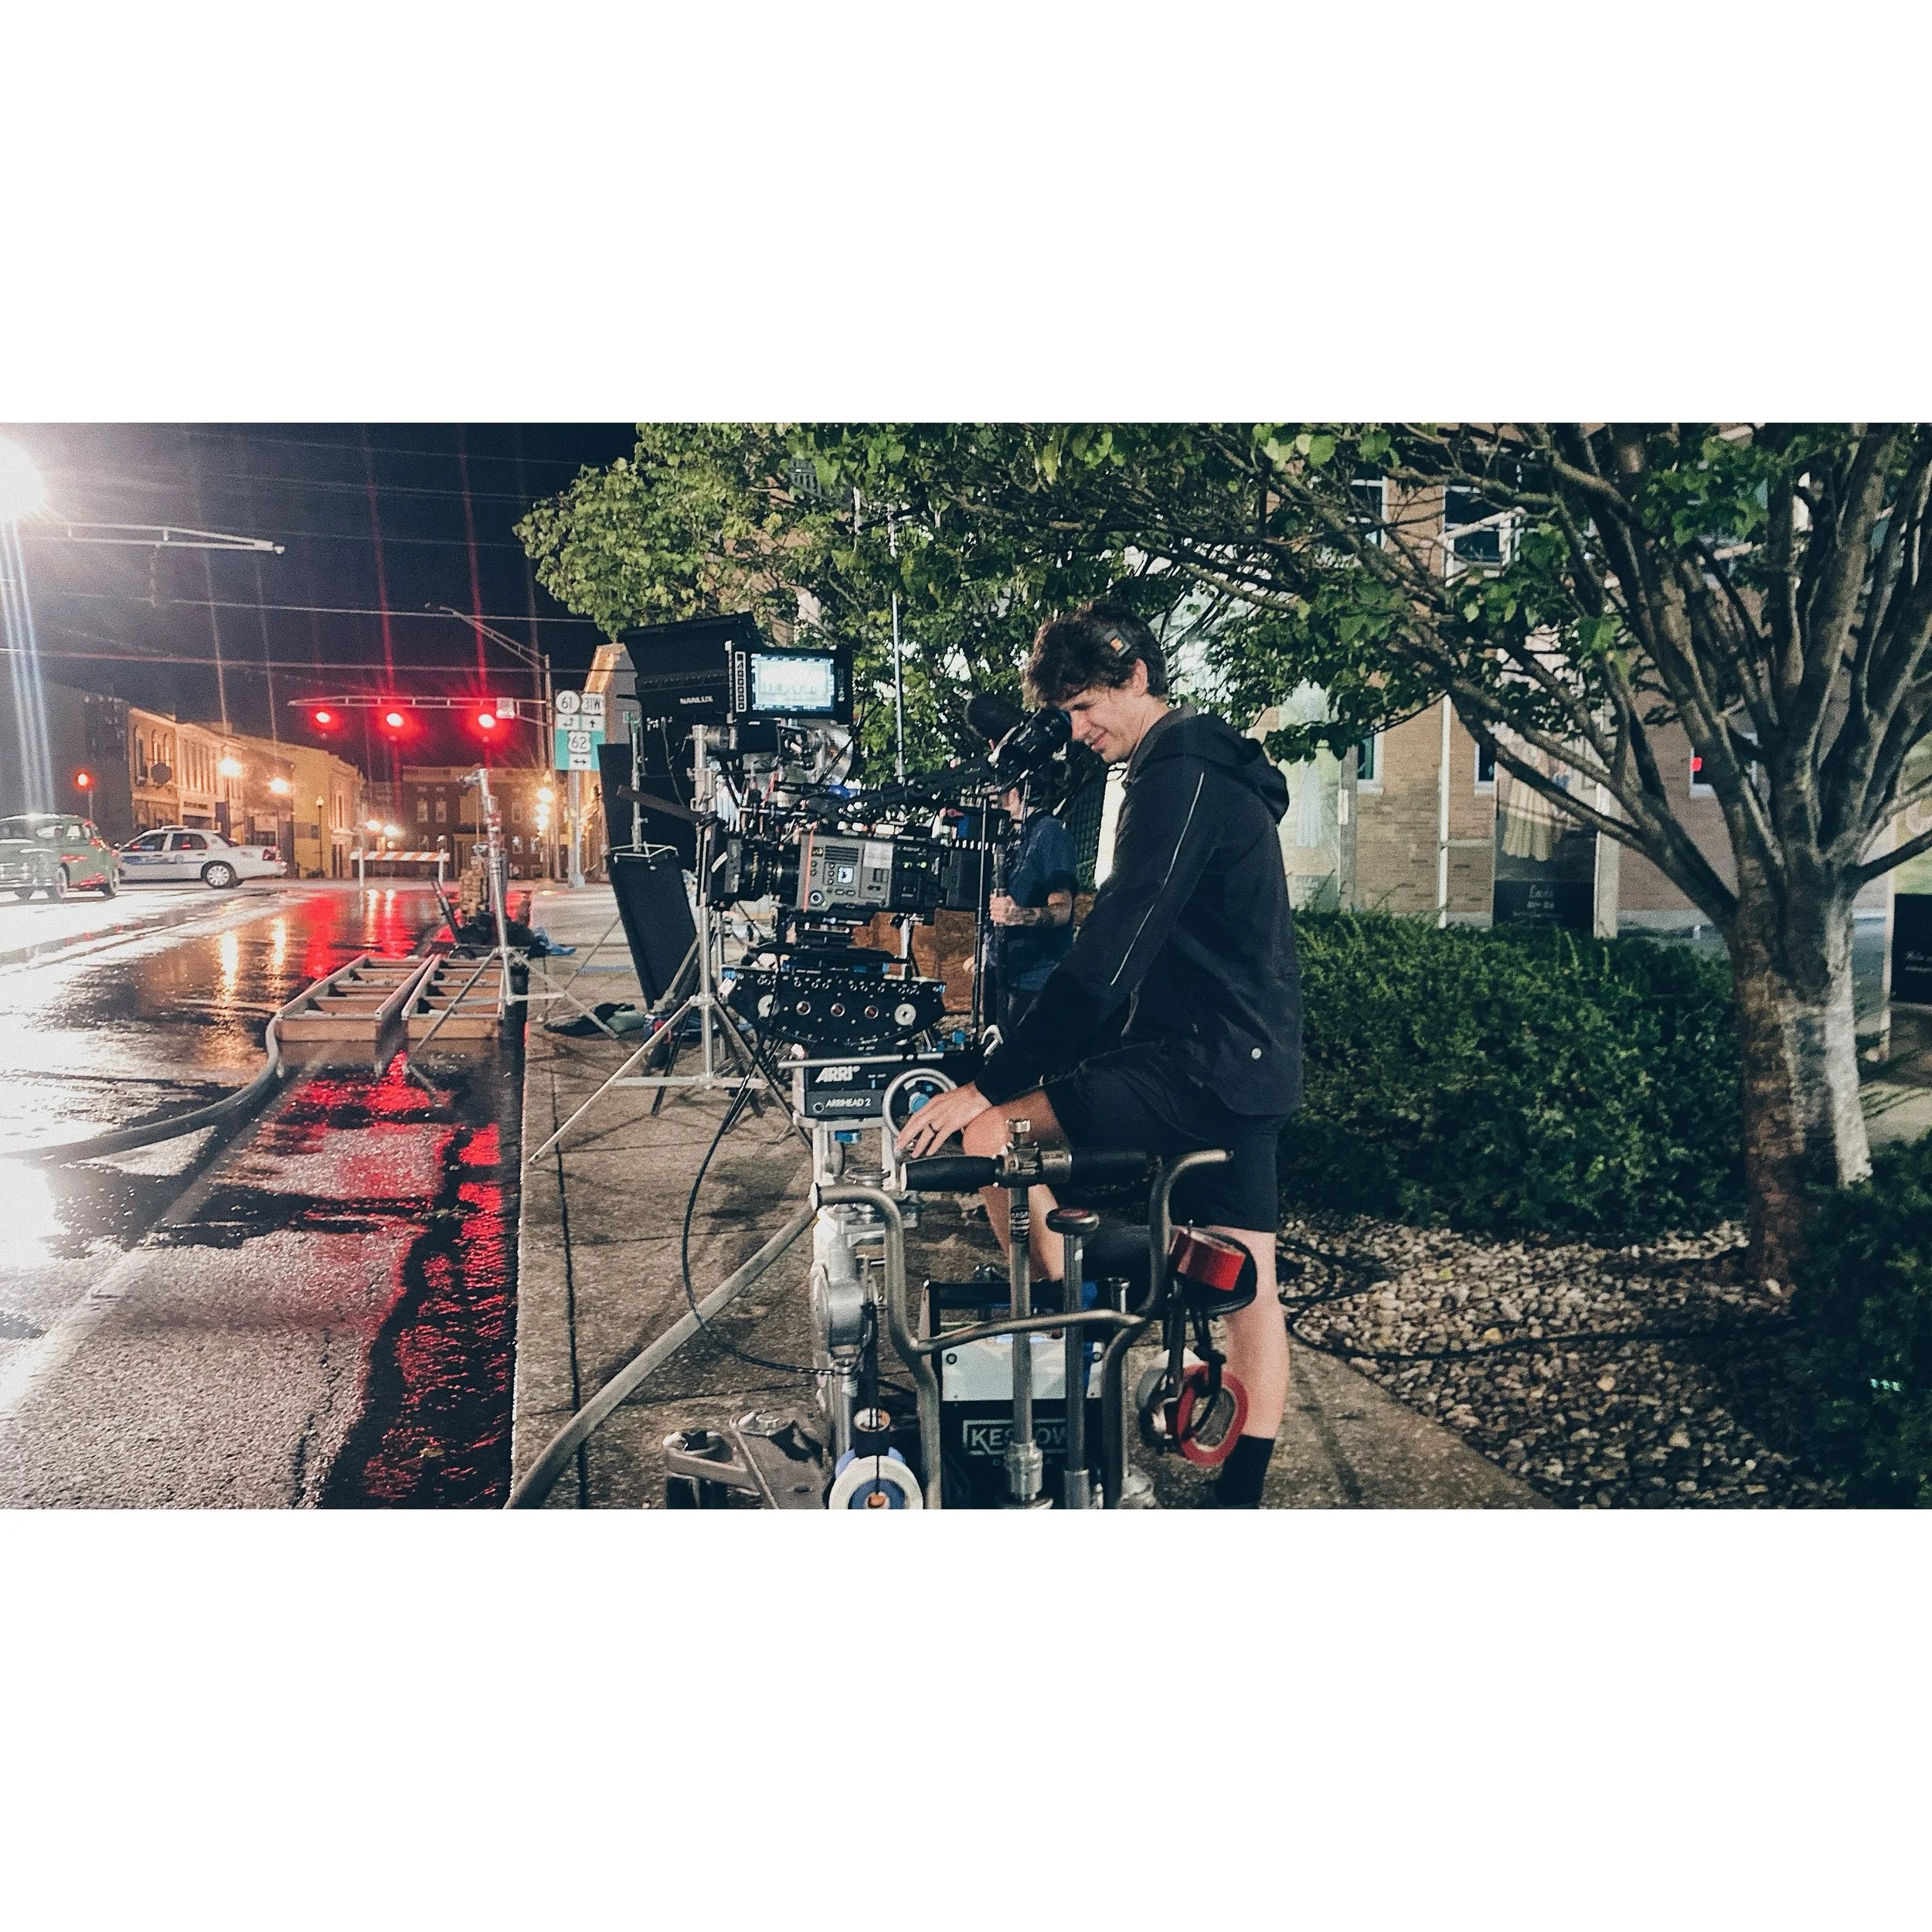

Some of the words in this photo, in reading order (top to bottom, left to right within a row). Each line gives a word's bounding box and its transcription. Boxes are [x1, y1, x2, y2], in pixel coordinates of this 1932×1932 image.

[561, 696, 573, 709] 61
[584, 697, 601, 710] 31W
[571, 736, 587, 750] 62
[815, 1066, 853, 1083] ARRI
[825, 1097, 865, 1108] ARRIHEAD
[865, 1097, 872, 1107] 2
[971, 1426, 1067, 1448] KESOW
